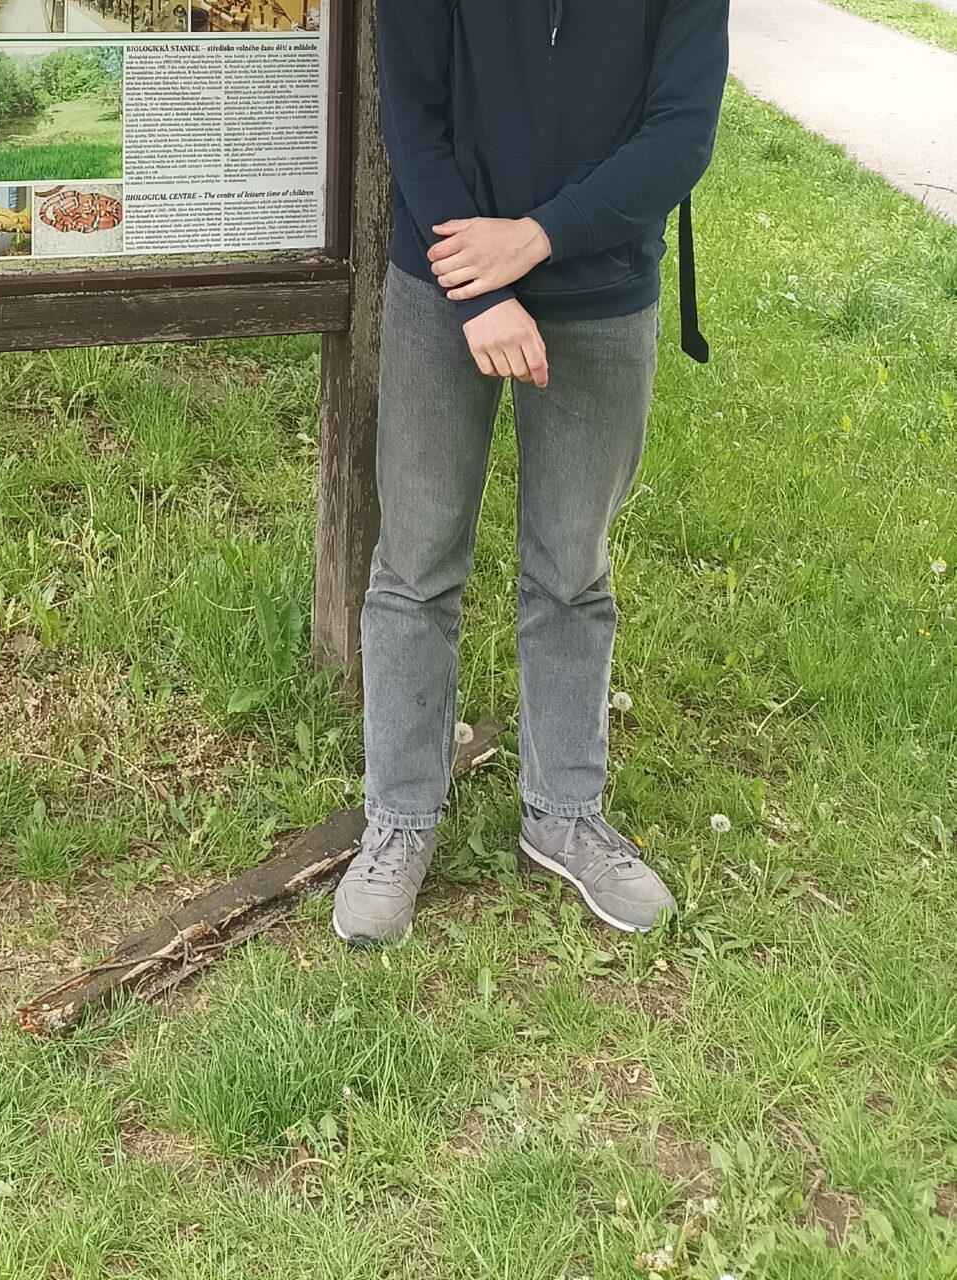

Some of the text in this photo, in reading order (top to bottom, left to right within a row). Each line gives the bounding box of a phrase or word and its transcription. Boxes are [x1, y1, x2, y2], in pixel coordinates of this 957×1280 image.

[126, 44, 169, 52] BIOLOGICKÁ
[171, 44, 200, 52] STANICE
[276, 43, 287, 51] dětí
[293, 43, 318, 51] mládeže
[125, 193, 168, 201] BIOLOGICAL
[169, 192, 197, 200] CENTRE
[204, 191, 215, 199] The
[237, 190, 244, 198] of
[244, 190, 265, 198] leisure
[289, 188, 314, 196] children
